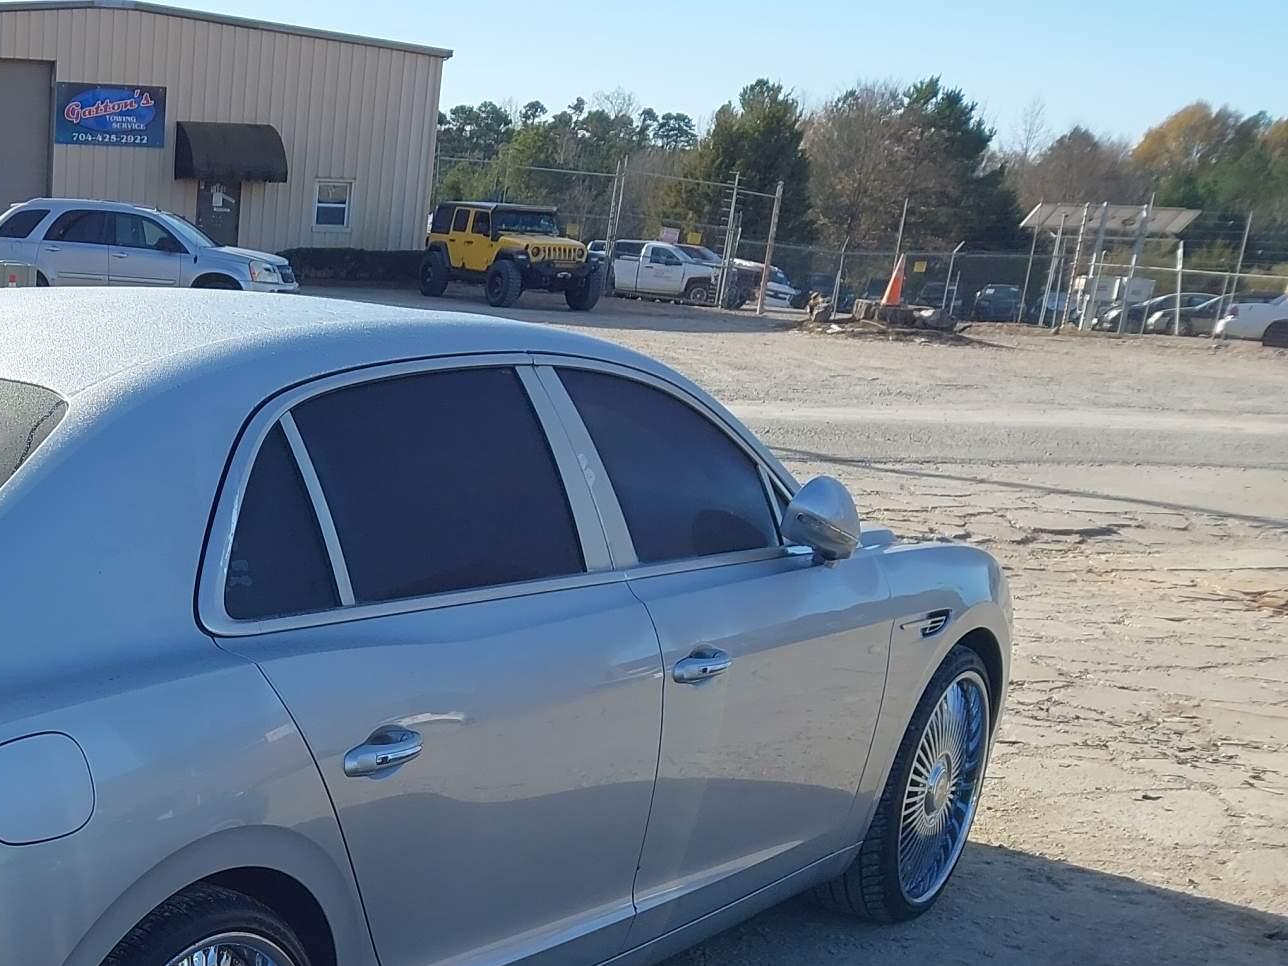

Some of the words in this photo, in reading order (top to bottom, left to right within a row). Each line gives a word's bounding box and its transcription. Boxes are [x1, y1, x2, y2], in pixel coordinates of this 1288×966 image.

[64, 89, 155, 123] Gatton's
[106, 115, 137, 123] TOWING
[112, 122, 146, 130] SERVICE
